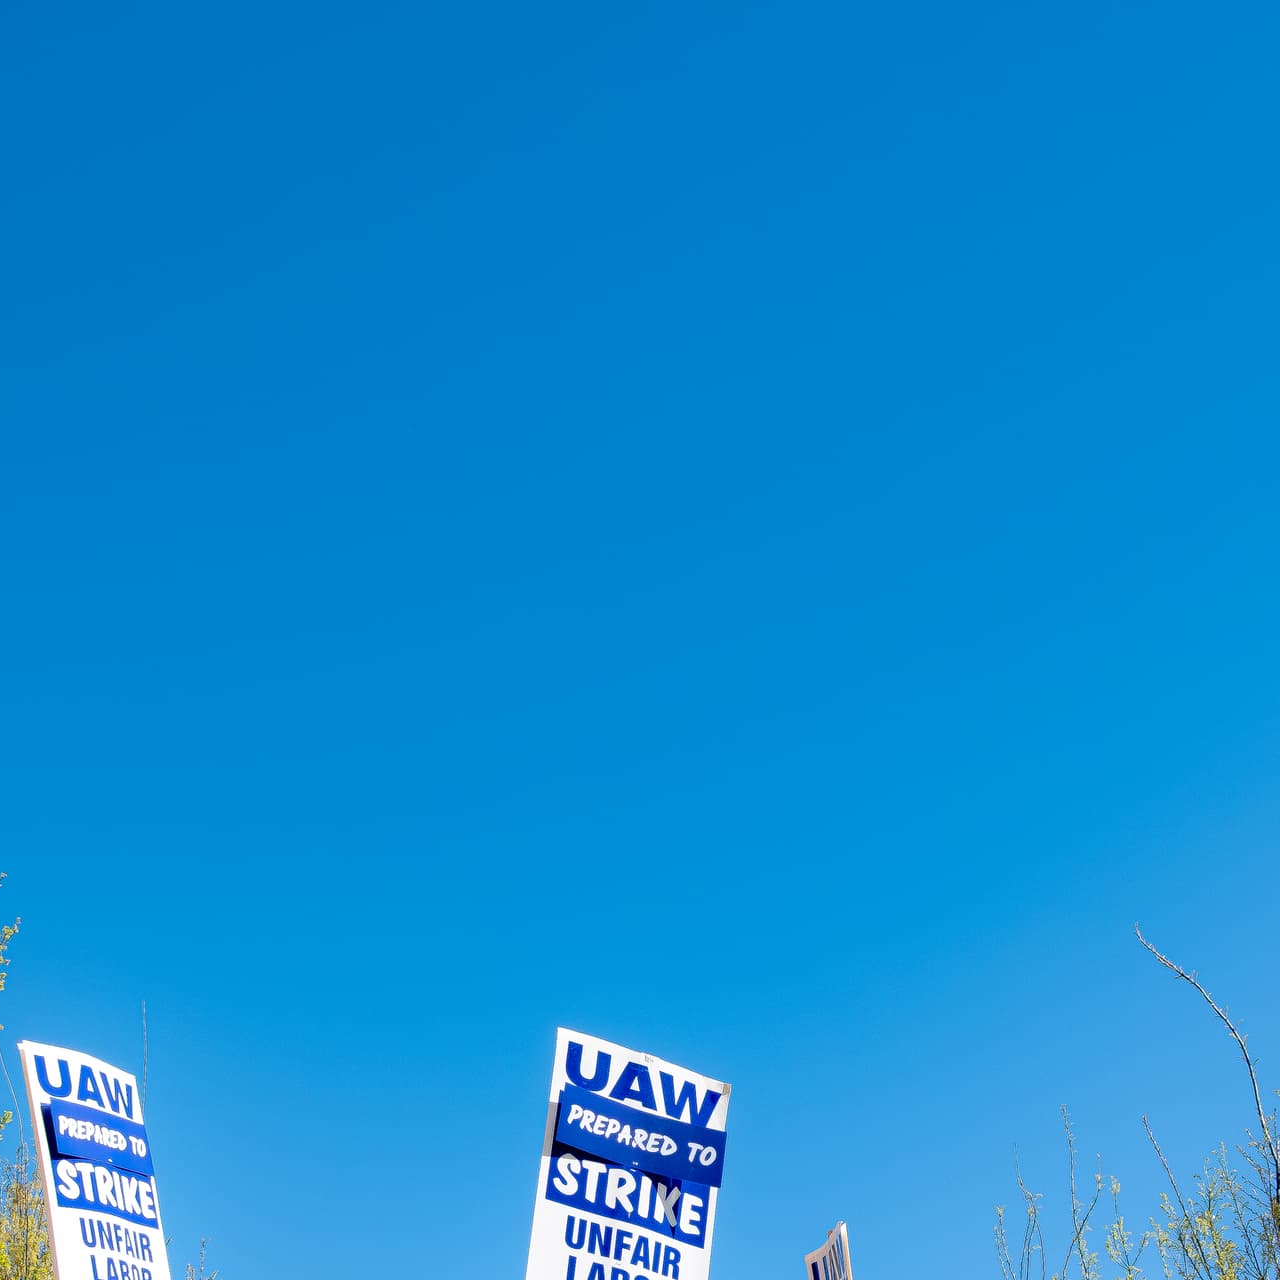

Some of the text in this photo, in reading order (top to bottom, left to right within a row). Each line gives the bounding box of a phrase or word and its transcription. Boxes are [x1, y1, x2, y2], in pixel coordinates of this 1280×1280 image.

[34, 1055, 133, 1120] UAW
[565, 1040, 721, 1129] UAW
[58, 1115, 146, 1158] PREPARED TO
[567, 1103, 717, 1167] PREPARED TO
[57, 1158, 157, 1220] STRIKE
[553, 1153, 703, 1236] STRIKE
[79, 1217, 154, 1263] UNFAIR
[564, 1214, 682, 1280] UNFAIR
